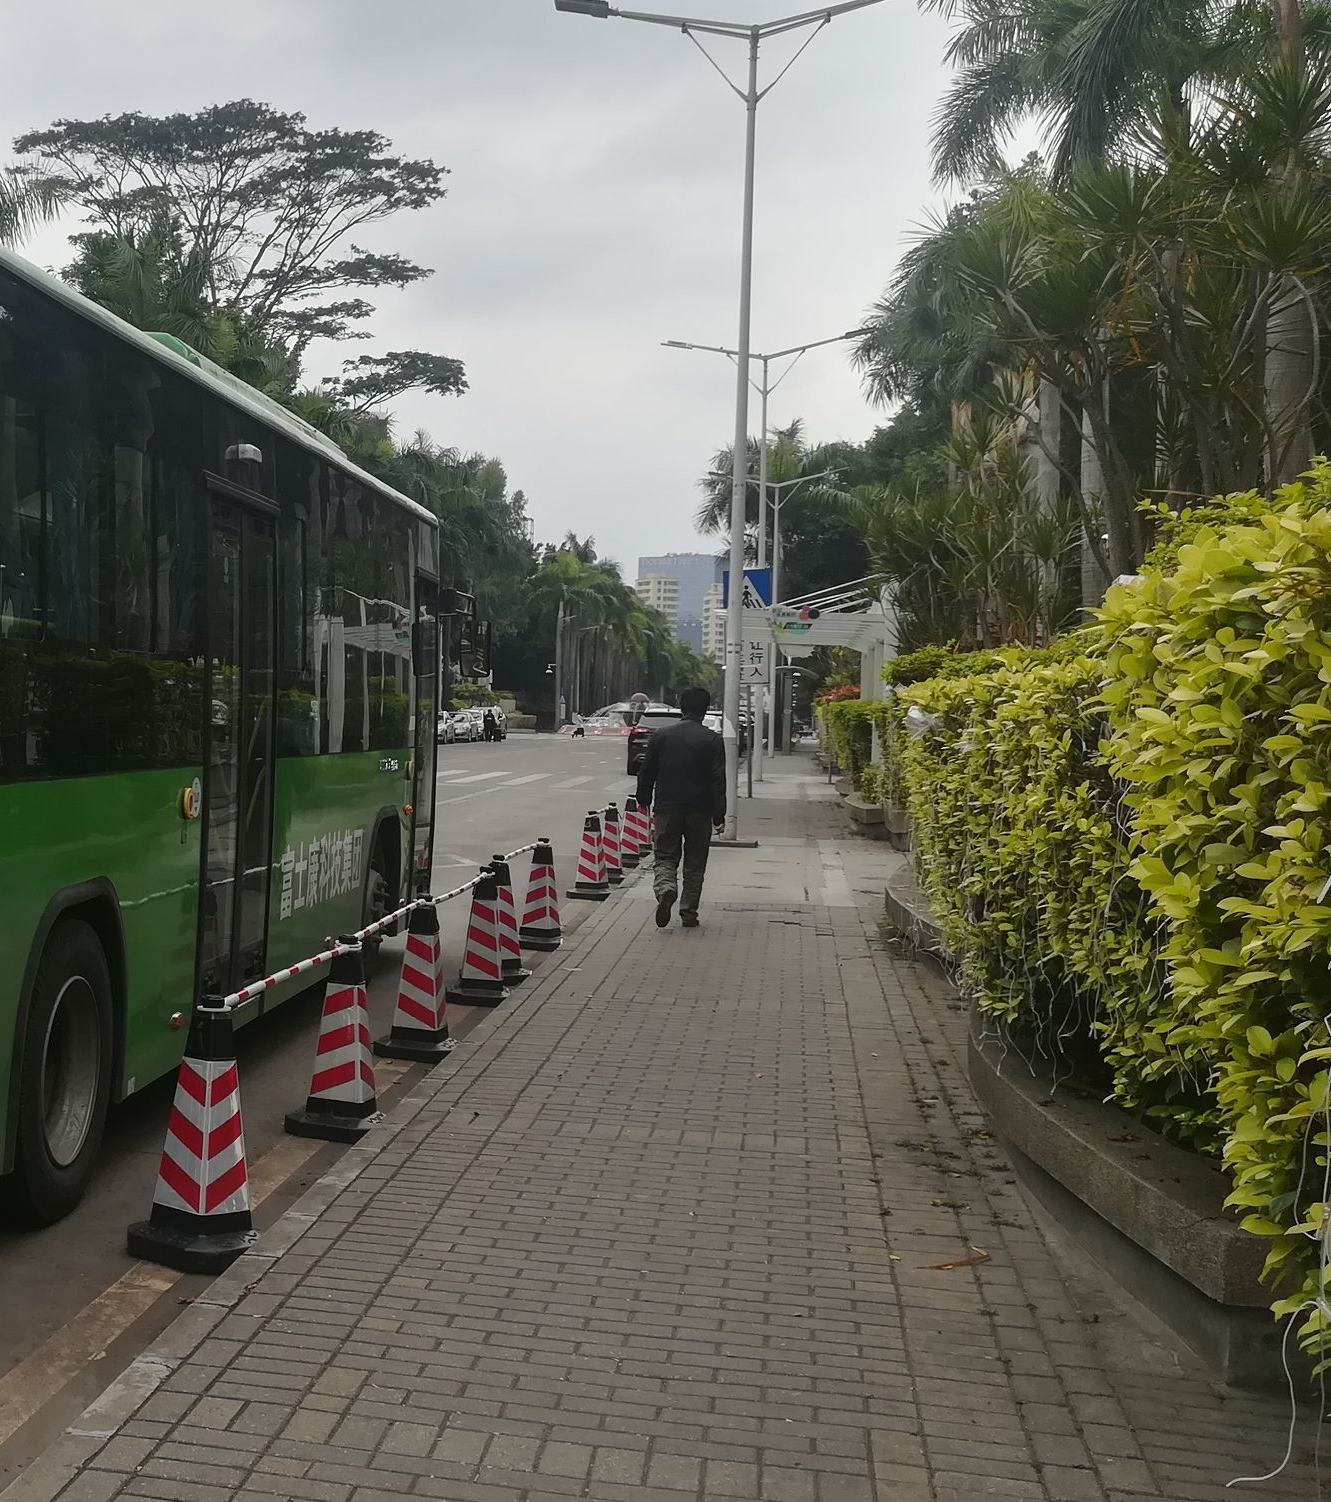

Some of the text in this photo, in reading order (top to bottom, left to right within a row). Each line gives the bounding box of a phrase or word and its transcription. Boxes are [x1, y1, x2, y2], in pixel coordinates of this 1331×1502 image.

[279, 828, 364, 921] 富士康科技集团
